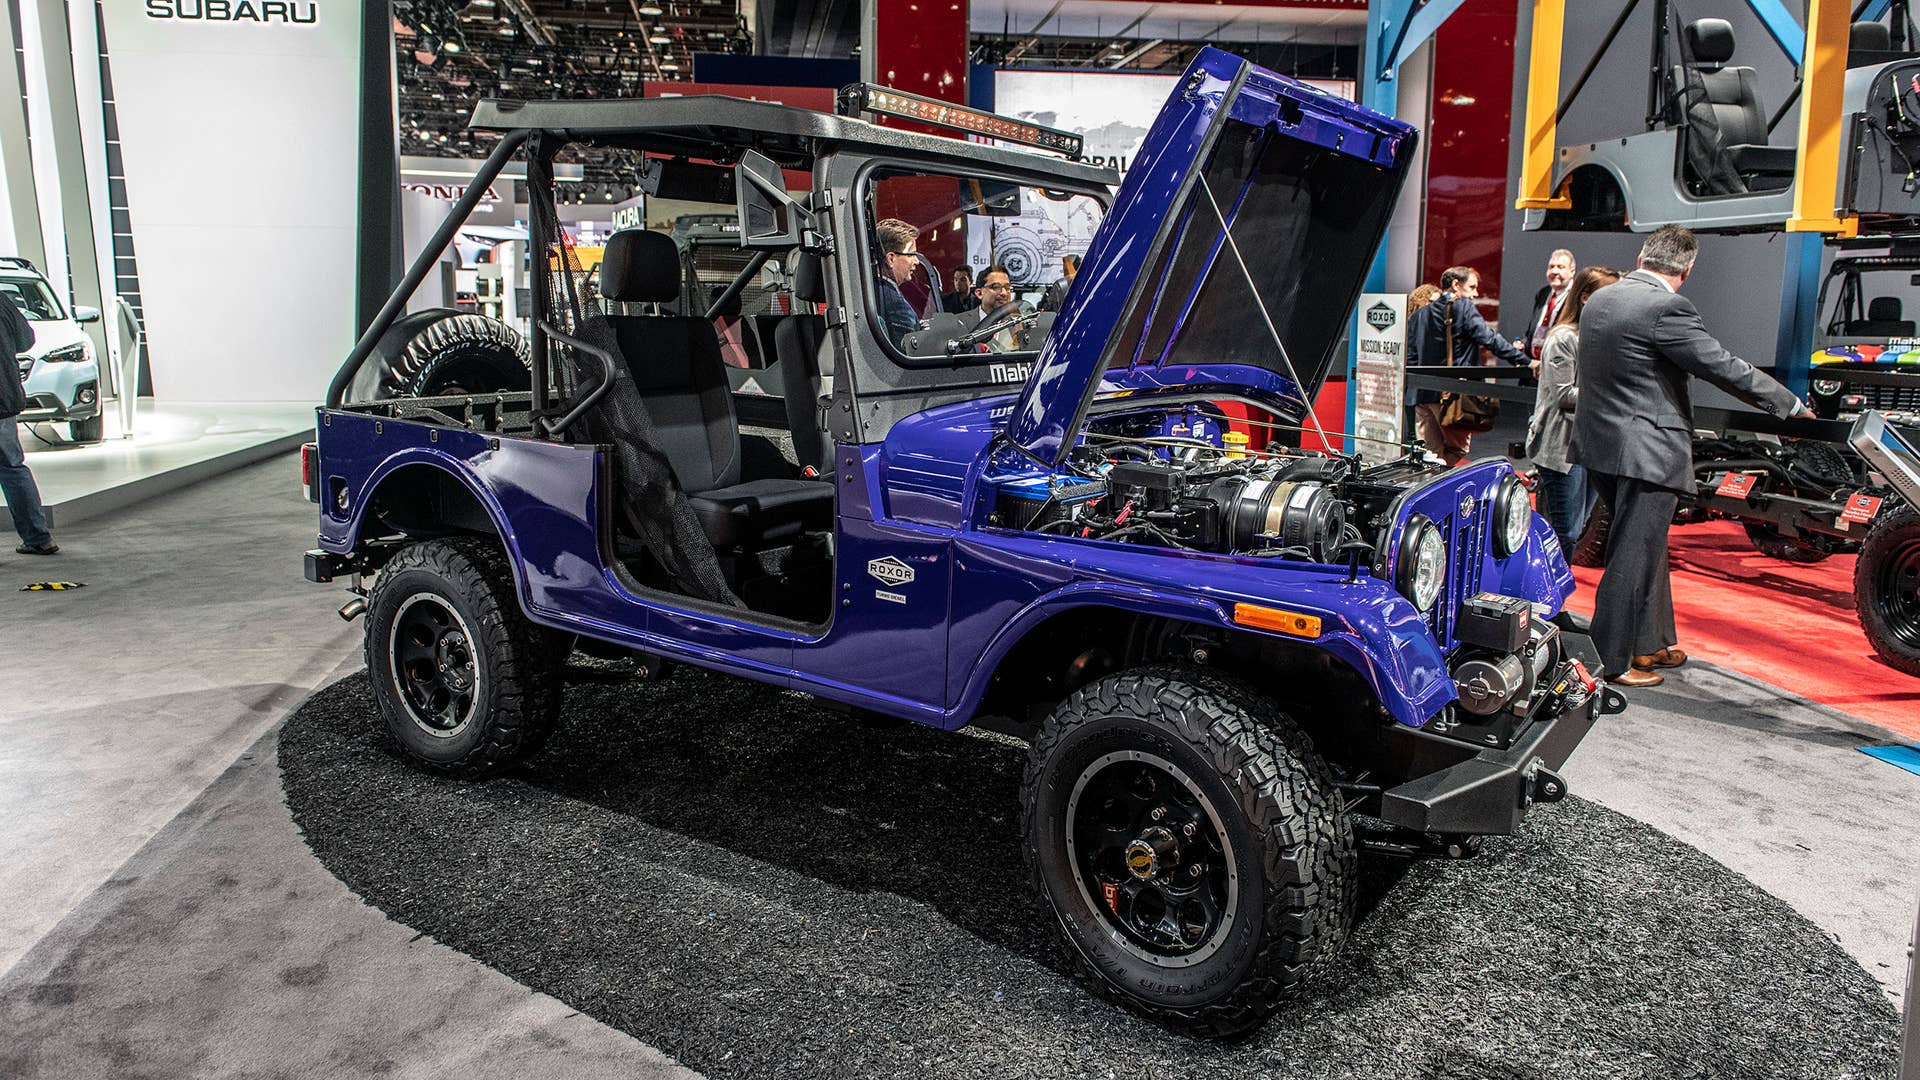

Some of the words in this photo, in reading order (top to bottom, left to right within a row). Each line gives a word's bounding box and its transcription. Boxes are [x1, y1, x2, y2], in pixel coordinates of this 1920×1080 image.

[146, 0, 317, 24] SUBARU
[616, 206, 640, 230] ACURA
[1367, 311, 1394, 322] ROXOR
[870, 563, 912, 580] ROXOR
